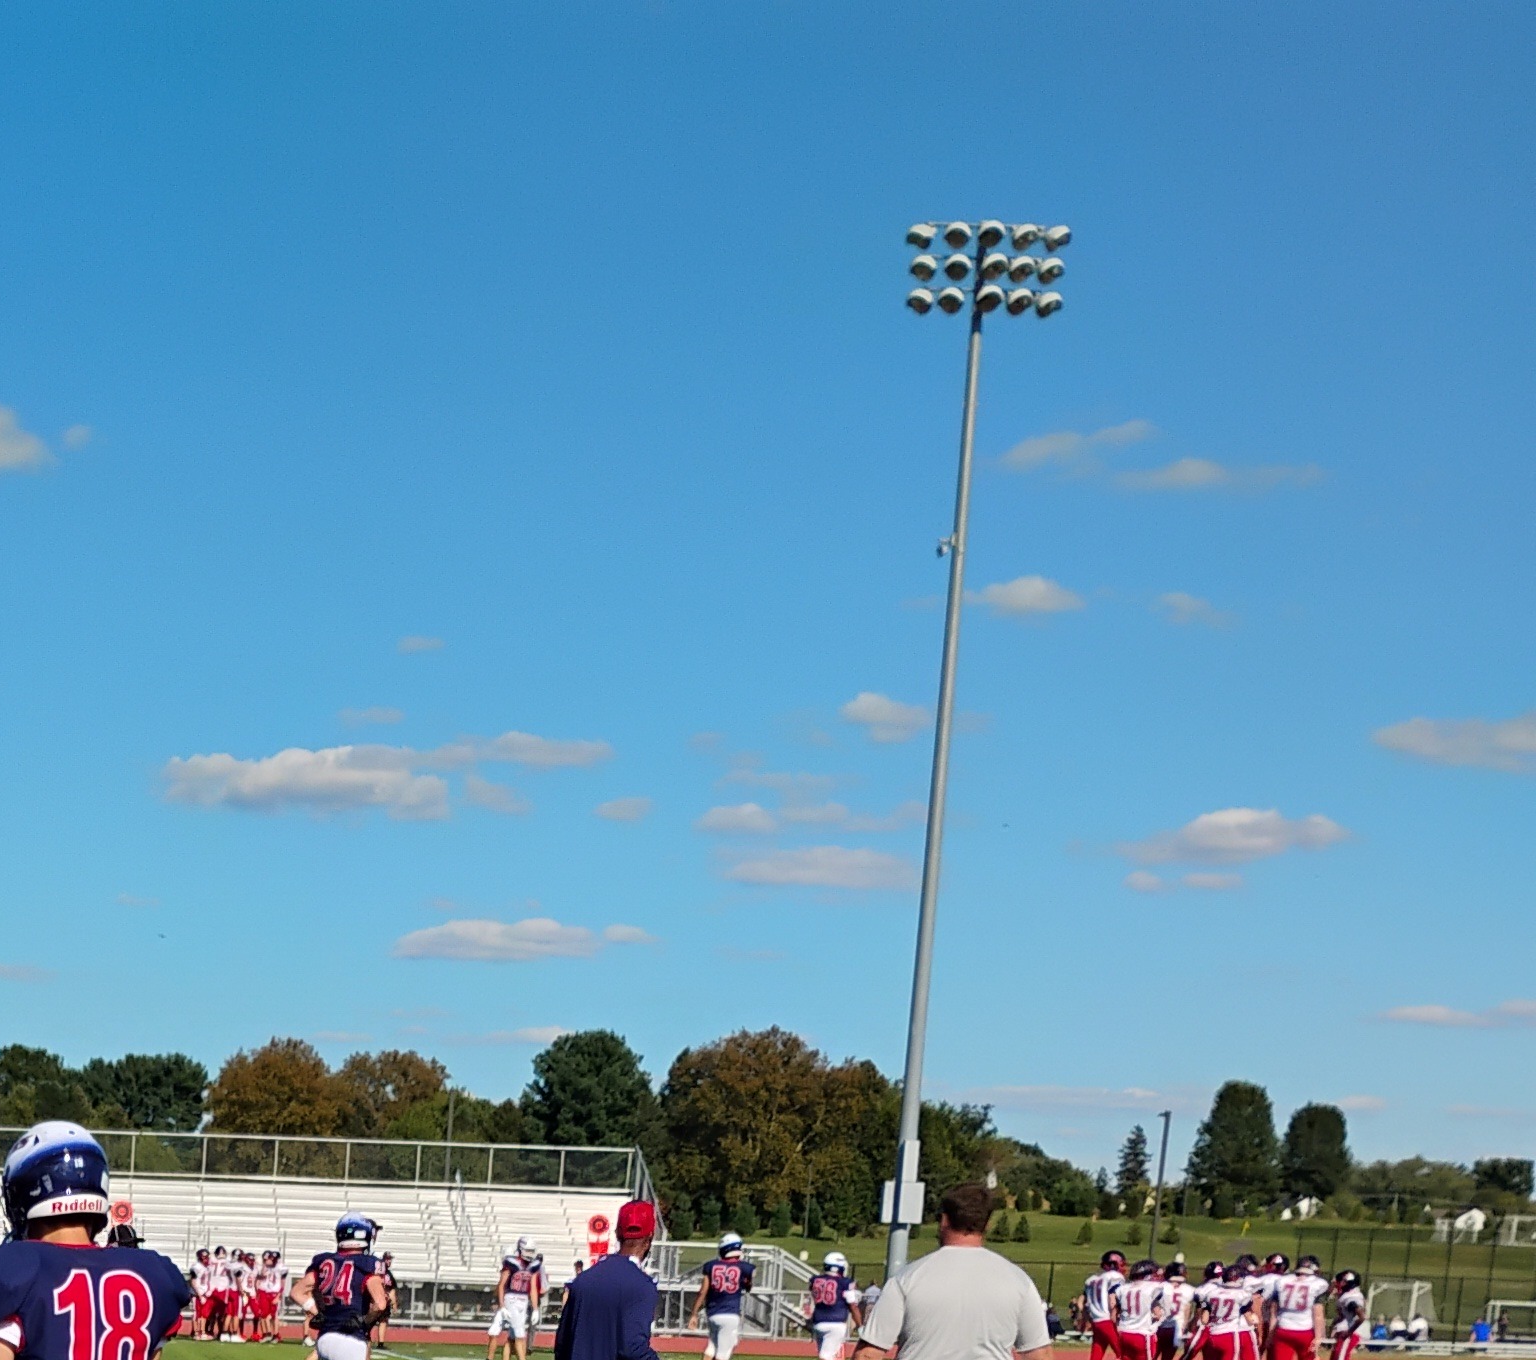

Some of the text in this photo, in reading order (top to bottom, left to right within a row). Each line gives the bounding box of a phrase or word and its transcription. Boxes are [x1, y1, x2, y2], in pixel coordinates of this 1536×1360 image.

[319, 1259, 354, 1306] 24
[711, 1265, 741, 1294] 53
[1126, 1290, 1141, 1316] 11
[1284, 1284, 1309, 1311] 73
